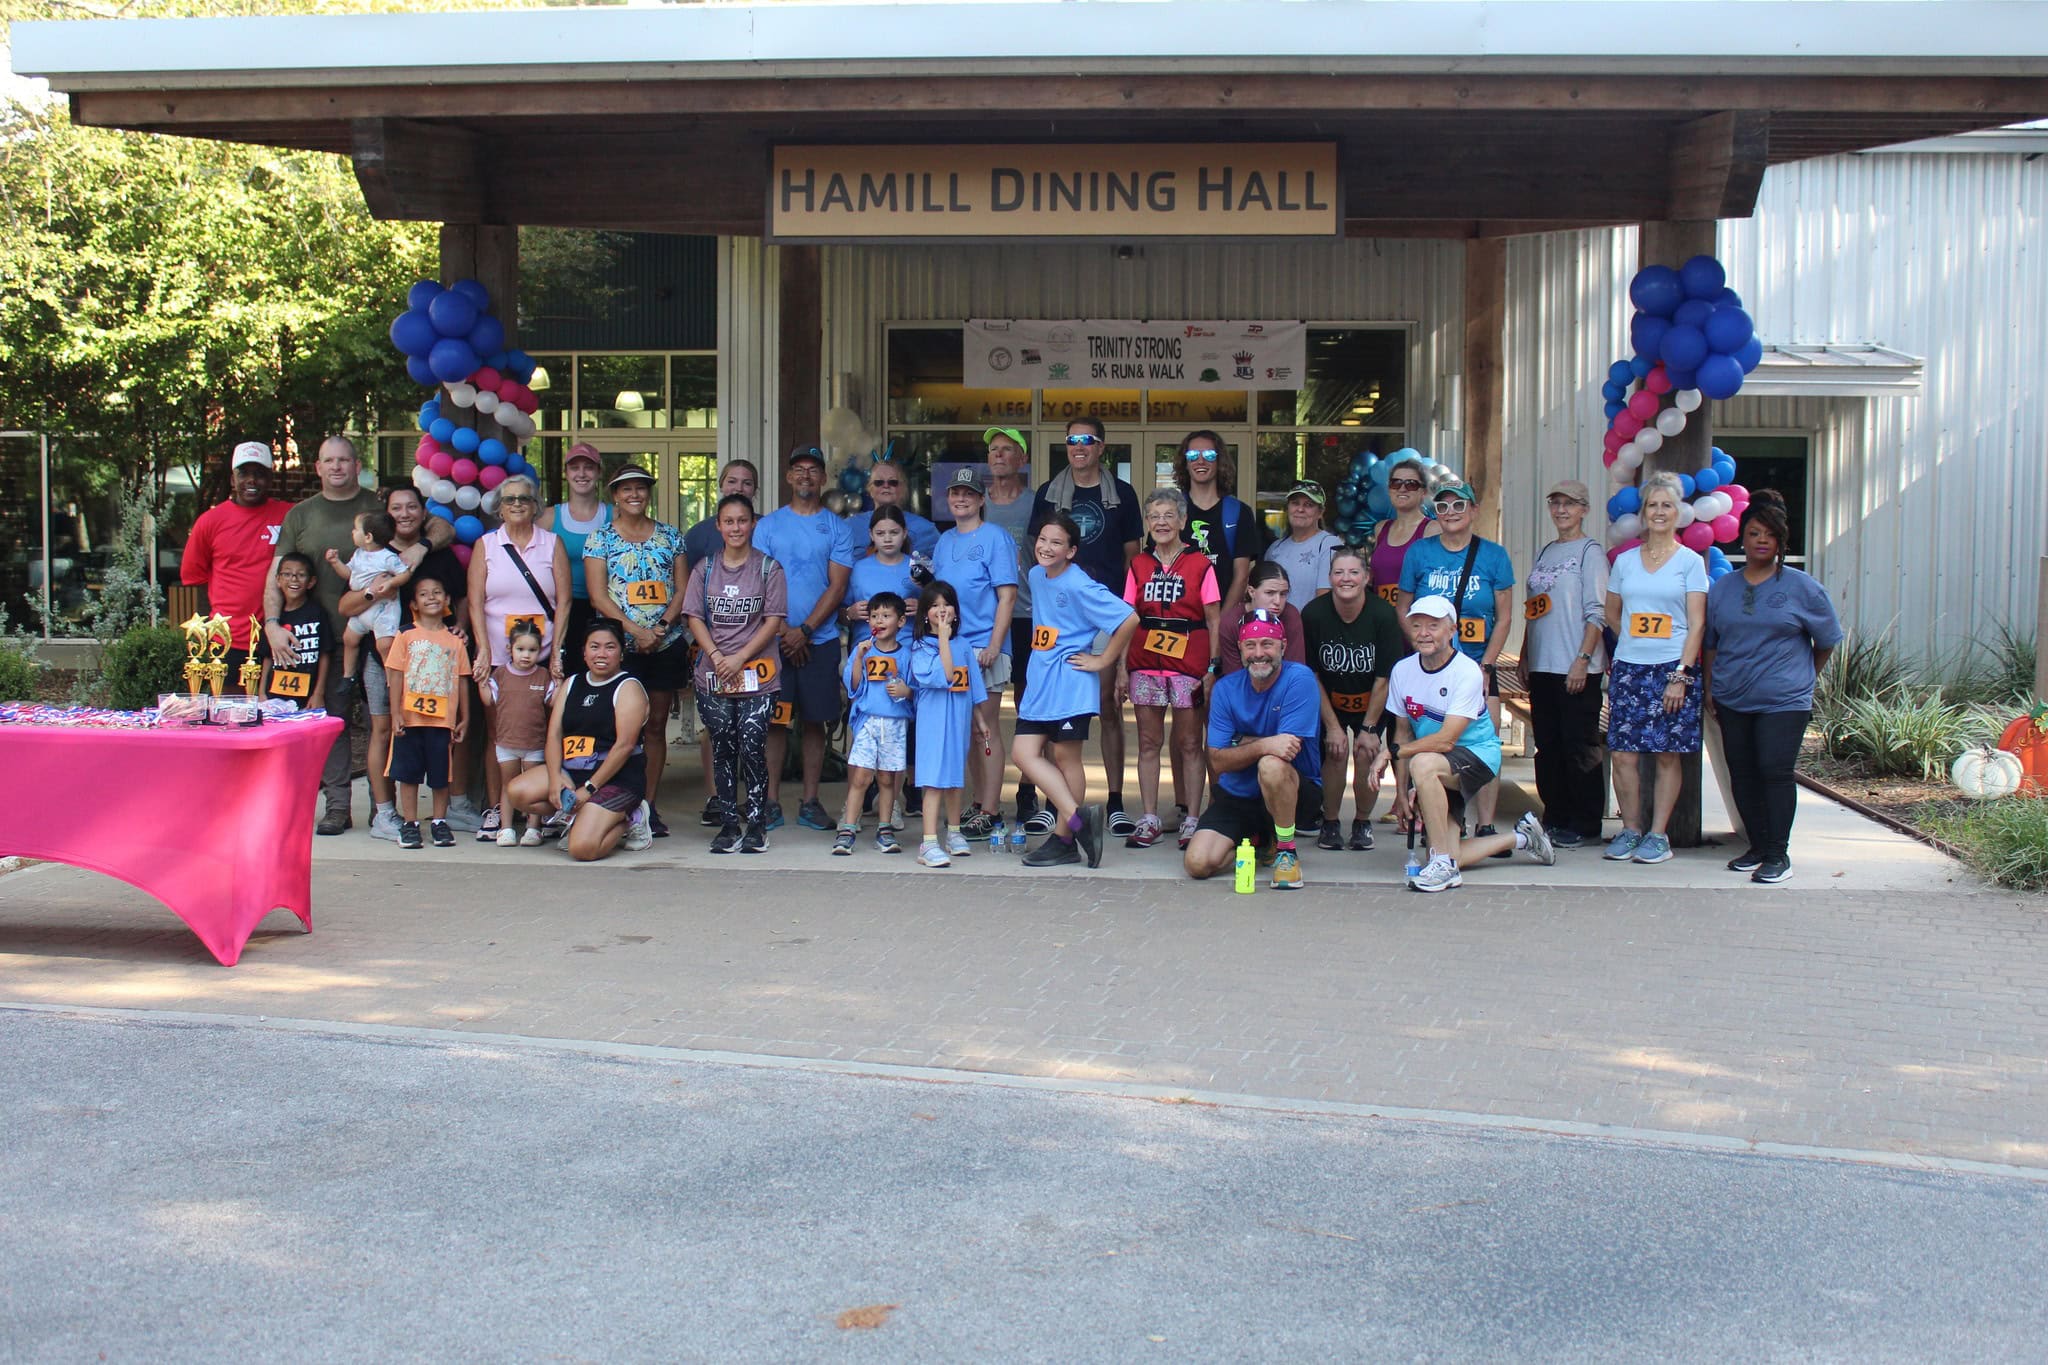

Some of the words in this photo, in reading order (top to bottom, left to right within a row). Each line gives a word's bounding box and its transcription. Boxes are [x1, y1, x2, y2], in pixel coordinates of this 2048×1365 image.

[781, 168, 972, 212] HAMILL
[991, 167, 1176, 212] DINING
[1198, 166, 1328, 211] HALL
[1087, 335, 1134, 359] TRINITY
[1135, 336, 1182, 360] STRONG
[1091, 363, 1107, 379] 5K
[1149, 363, 1185, 380] WALK
[982, 402, 991, 417] A
[997, 402, 1056, 417] LEGAY
[1062, 401, 1083, 417] OF
[1088, 401, 1188, 417] GENERSITY
[1428, 573, 1449, 590] WHO
[1452, 575, 1480, 592] LES
[636, 585, 659, 600] 41
[1143, 581, 1183, 603] BEEF
[1382, 587, 1398, 603] 26
[707, 596, 734, 613] EXAS
[1531, 598, 1546, 617] 39
[294, 622, 320, 636] MY
[1638, 616, 1663, 634] 37
[1034, 630, 1050, 647] 19
[1152, 632, 1179, 652] 27
[1319, 643, 1375, 673] COACH
[868, 660, 889, 677] 22
[279, 675, 300, 693] 44
[413, 697, 437, 714] 43
[1340, 697, 1363, 710] 28
[565, 737, 586, 755] 24
